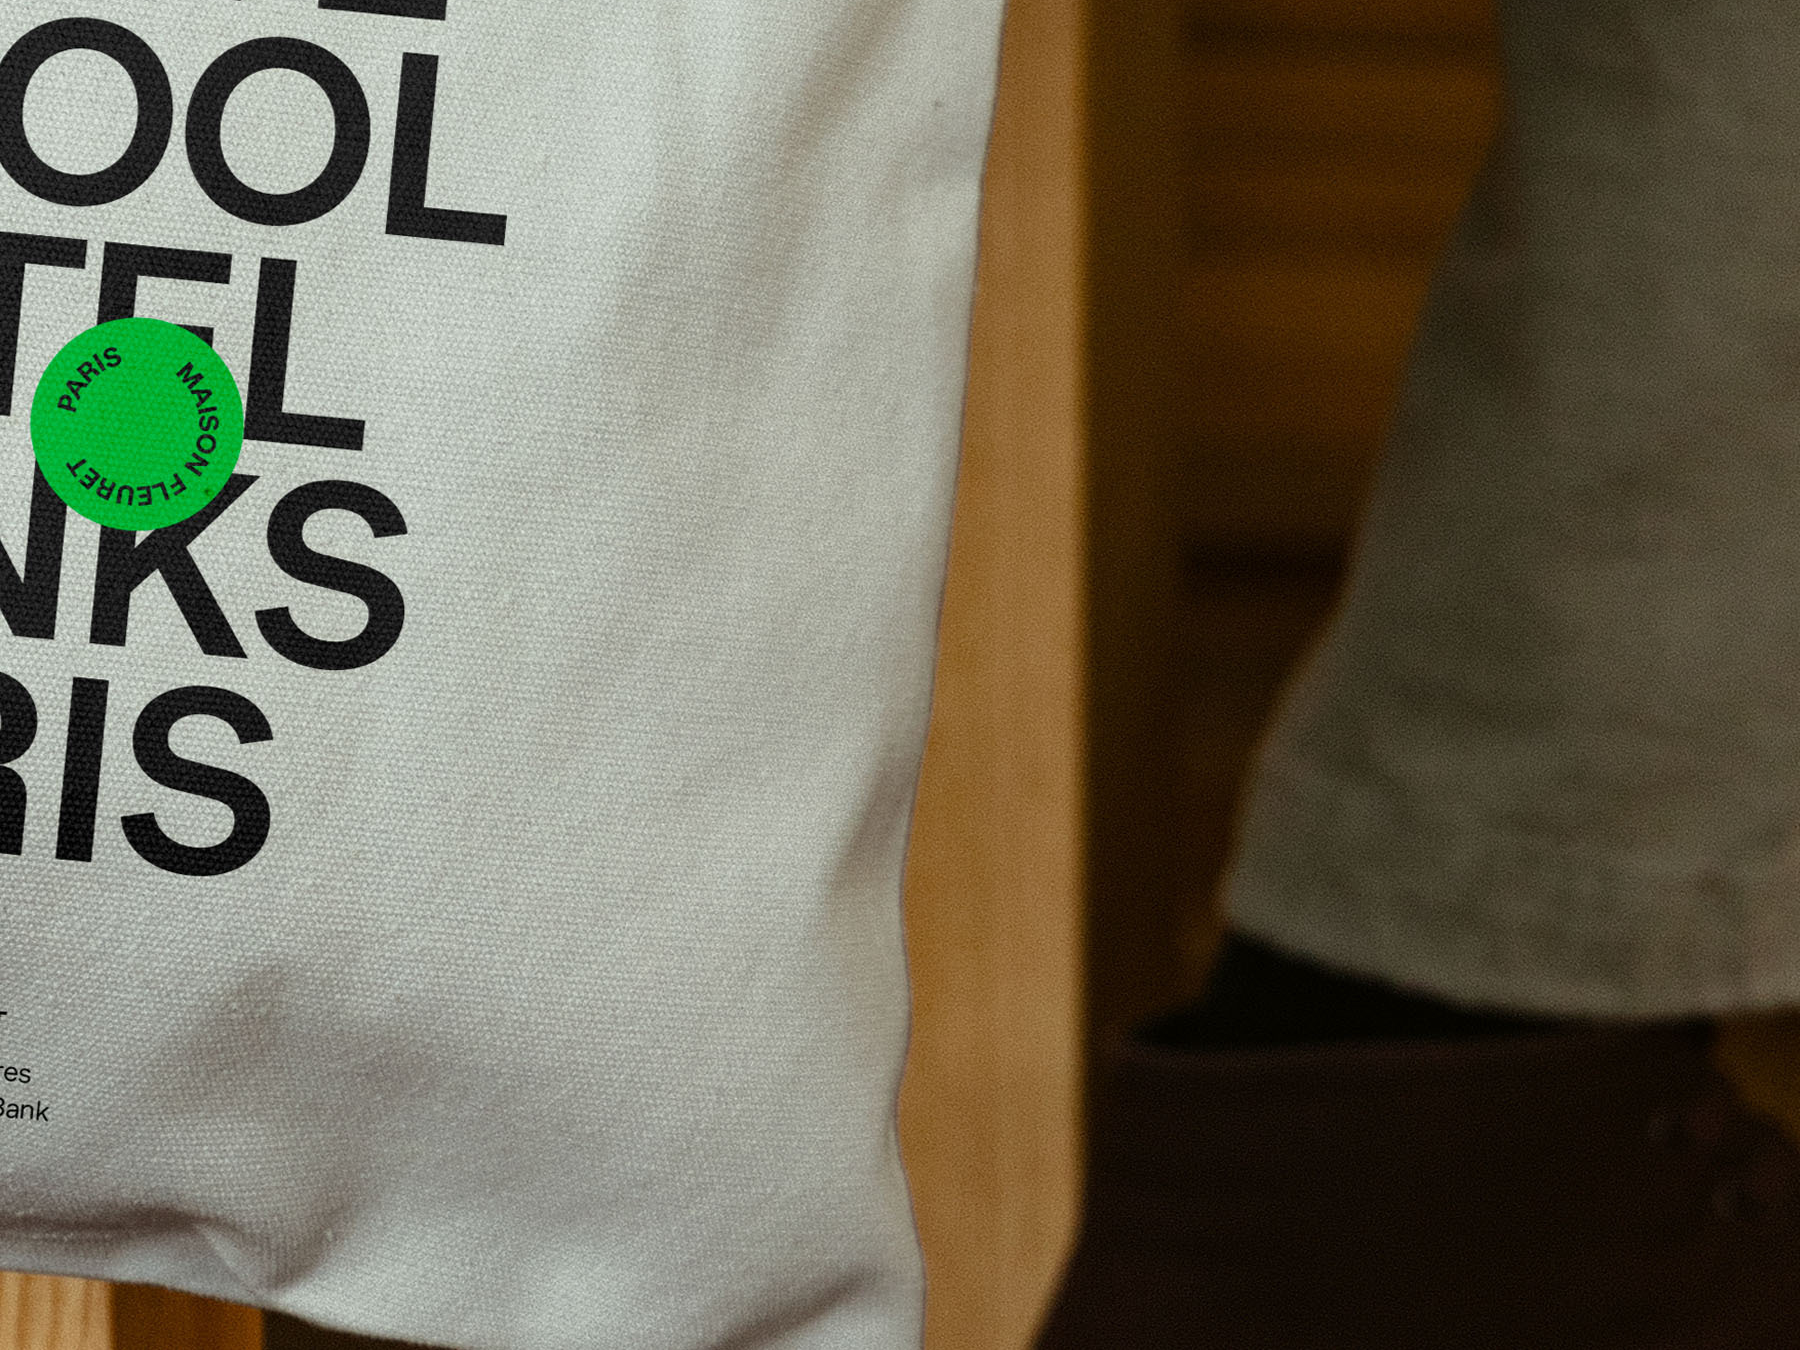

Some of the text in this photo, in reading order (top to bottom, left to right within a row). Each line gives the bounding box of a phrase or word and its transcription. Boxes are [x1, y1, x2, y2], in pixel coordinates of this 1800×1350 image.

[56, 346, 122, 413] PARIS
[65, 361, 220, 507] MAISON FLEURET
